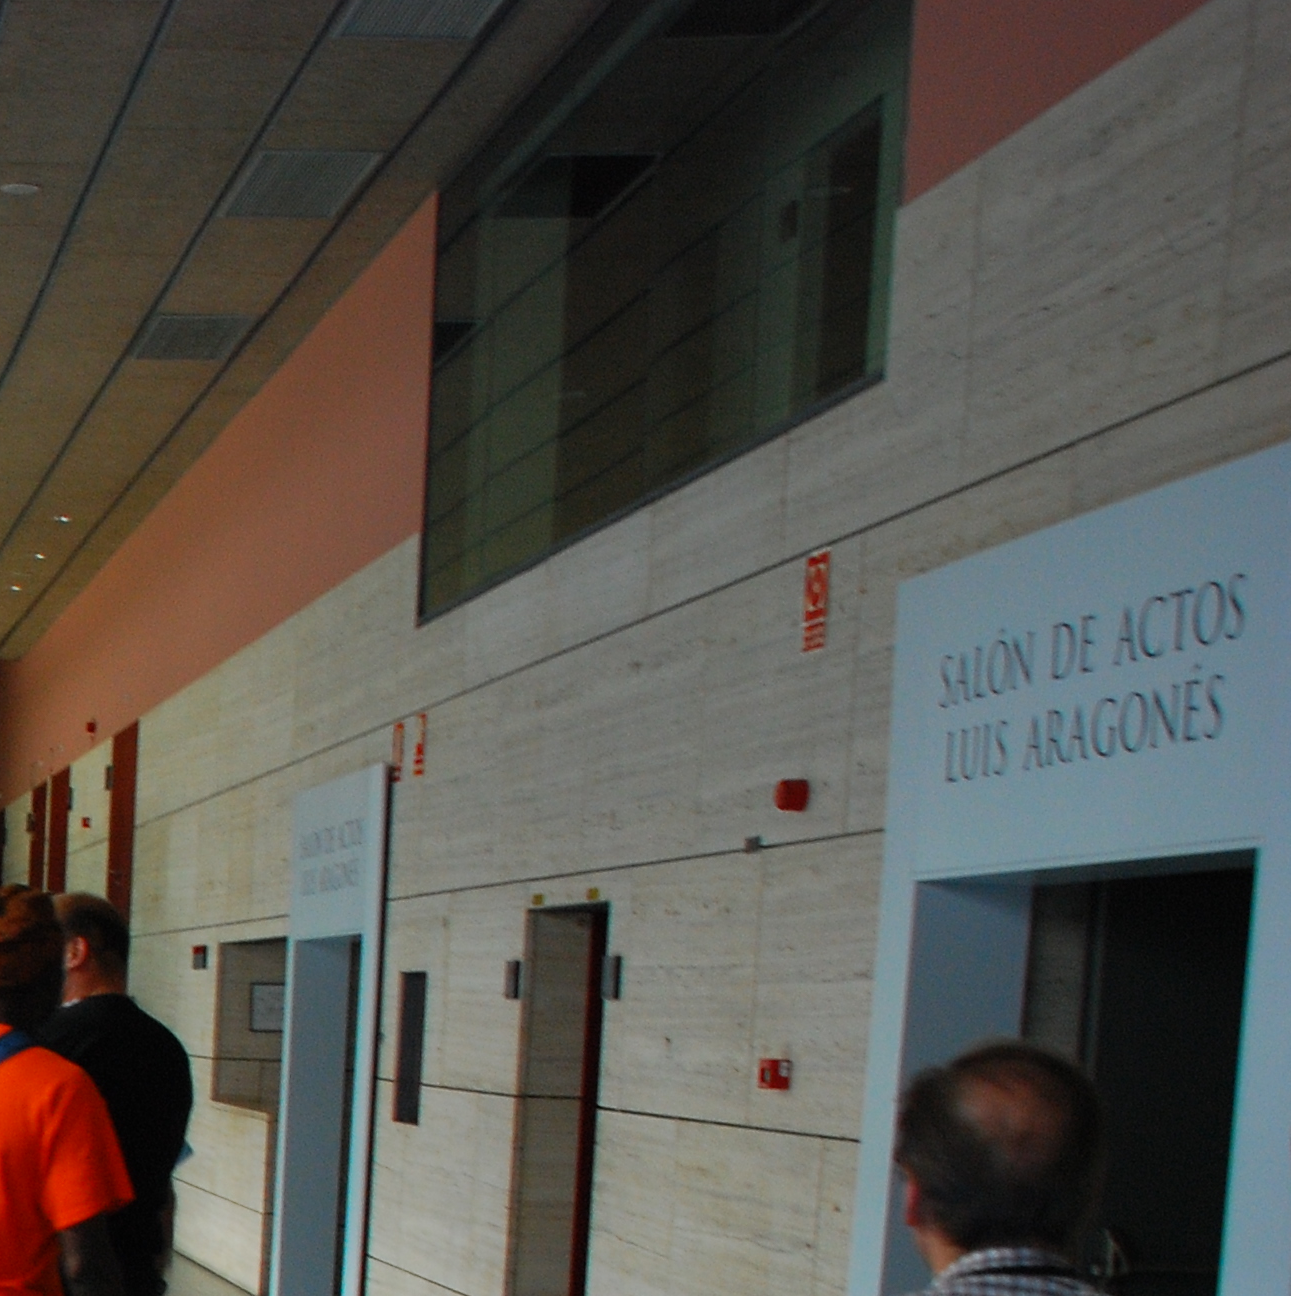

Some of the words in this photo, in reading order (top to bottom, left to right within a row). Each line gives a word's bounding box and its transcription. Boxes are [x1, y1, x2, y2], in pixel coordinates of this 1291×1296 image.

[937, 627, 1035, 709] SALÓN
[1051, 613, 1097, 681] DE
[1112, 571, 1246, 667] ACTOS
[944, 719, 1009, 783] LUIS
[1022, 662, 1225, 771] ARAGONÉS
